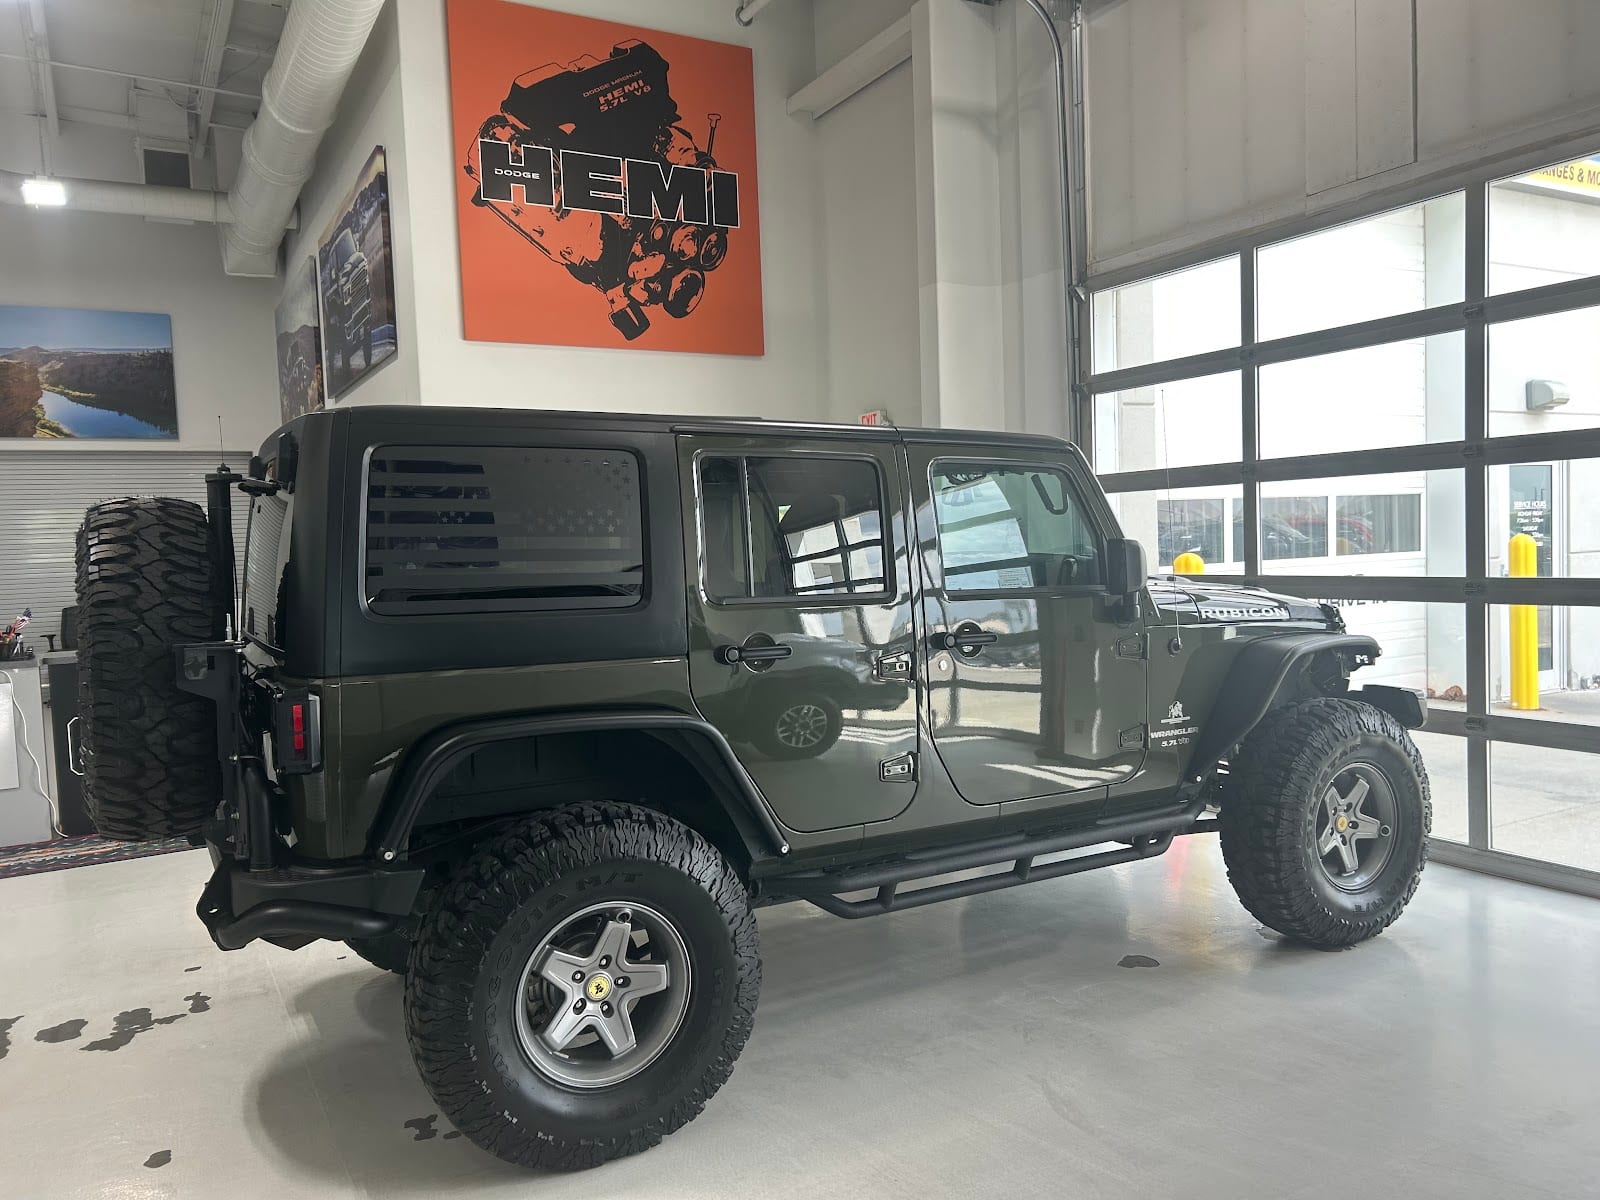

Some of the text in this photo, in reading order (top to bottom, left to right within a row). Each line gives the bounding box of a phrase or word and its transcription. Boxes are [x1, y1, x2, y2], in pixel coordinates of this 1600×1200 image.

[583, 69, 643, 98] DODGE MAGNUM
[598, 79, 645, 104] HEMI
[599, 85, 652, 113] 5.7L V8
[478, 138, 740, 228] HEMI
[494, 168, 541, 180] DODGE
[1577, 168, 1585, 183] &
[1200, 607, 1287, 619] RUBICON
[1150, 727, 1199, 738] WRANGLER
